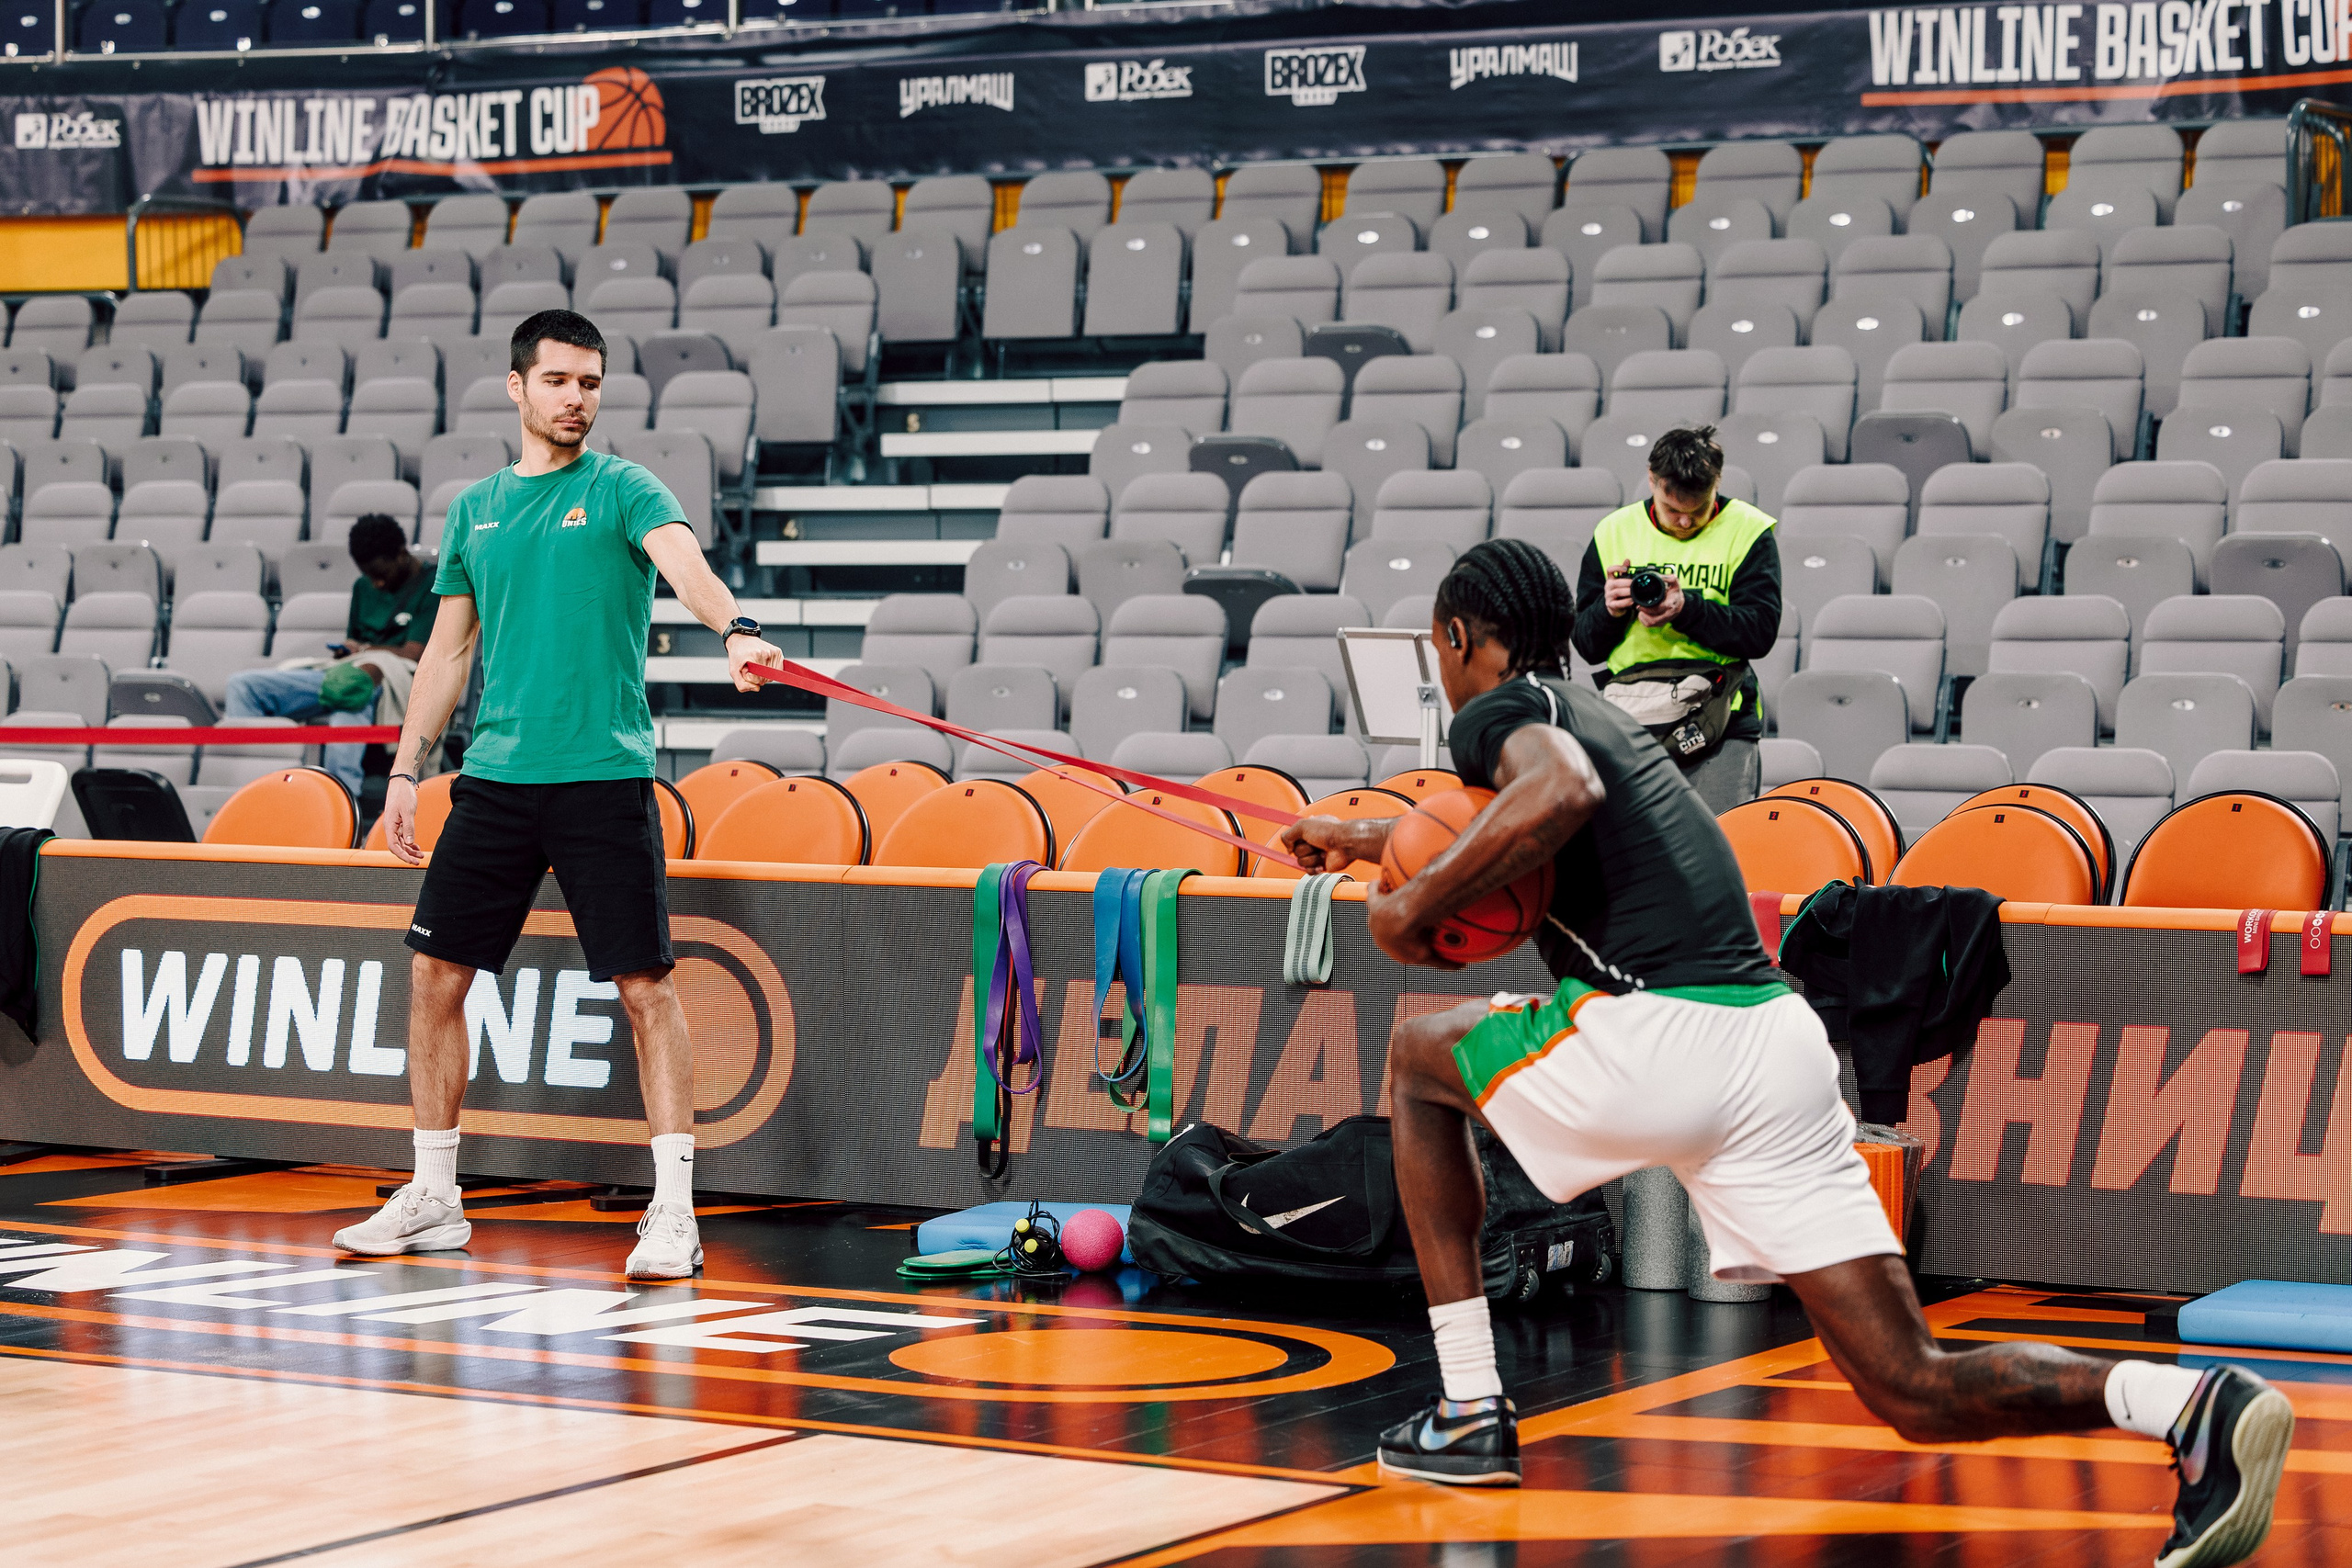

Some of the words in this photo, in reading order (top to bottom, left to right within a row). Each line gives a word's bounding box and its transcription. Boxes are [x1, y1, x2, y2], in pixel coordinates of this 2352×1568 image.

[1699, 26, 1782, 62] Робек
[1869, 3, 2083, 86] WINLINE
[2095, 0, 2271, 80] BASKET
[1120, 58, 1193, 92] Робек
[1272, 51, 1361, 89] BROZEX
[1450, 40, 1578, 90] УРАЛМАШ
[741, 83, 821, 117] BROZEX
[899, 72, 1014, 118] УРАЛМАШ
[196, 97, 377, 165] WINLINE
[380, 89, 523, 160] BASKET
[530, 84, 600, 155] CUP
[474, 521, 500, 531] MAXX
[561, 516, 587, 528] UNICS
[1679, 731, 1705, 751] CITY
[411, 923, 432, 937] MAXX
[120, 948, 619, 1089] WINLNE
[919, 975, 1484, 1154] ДЕЛА
